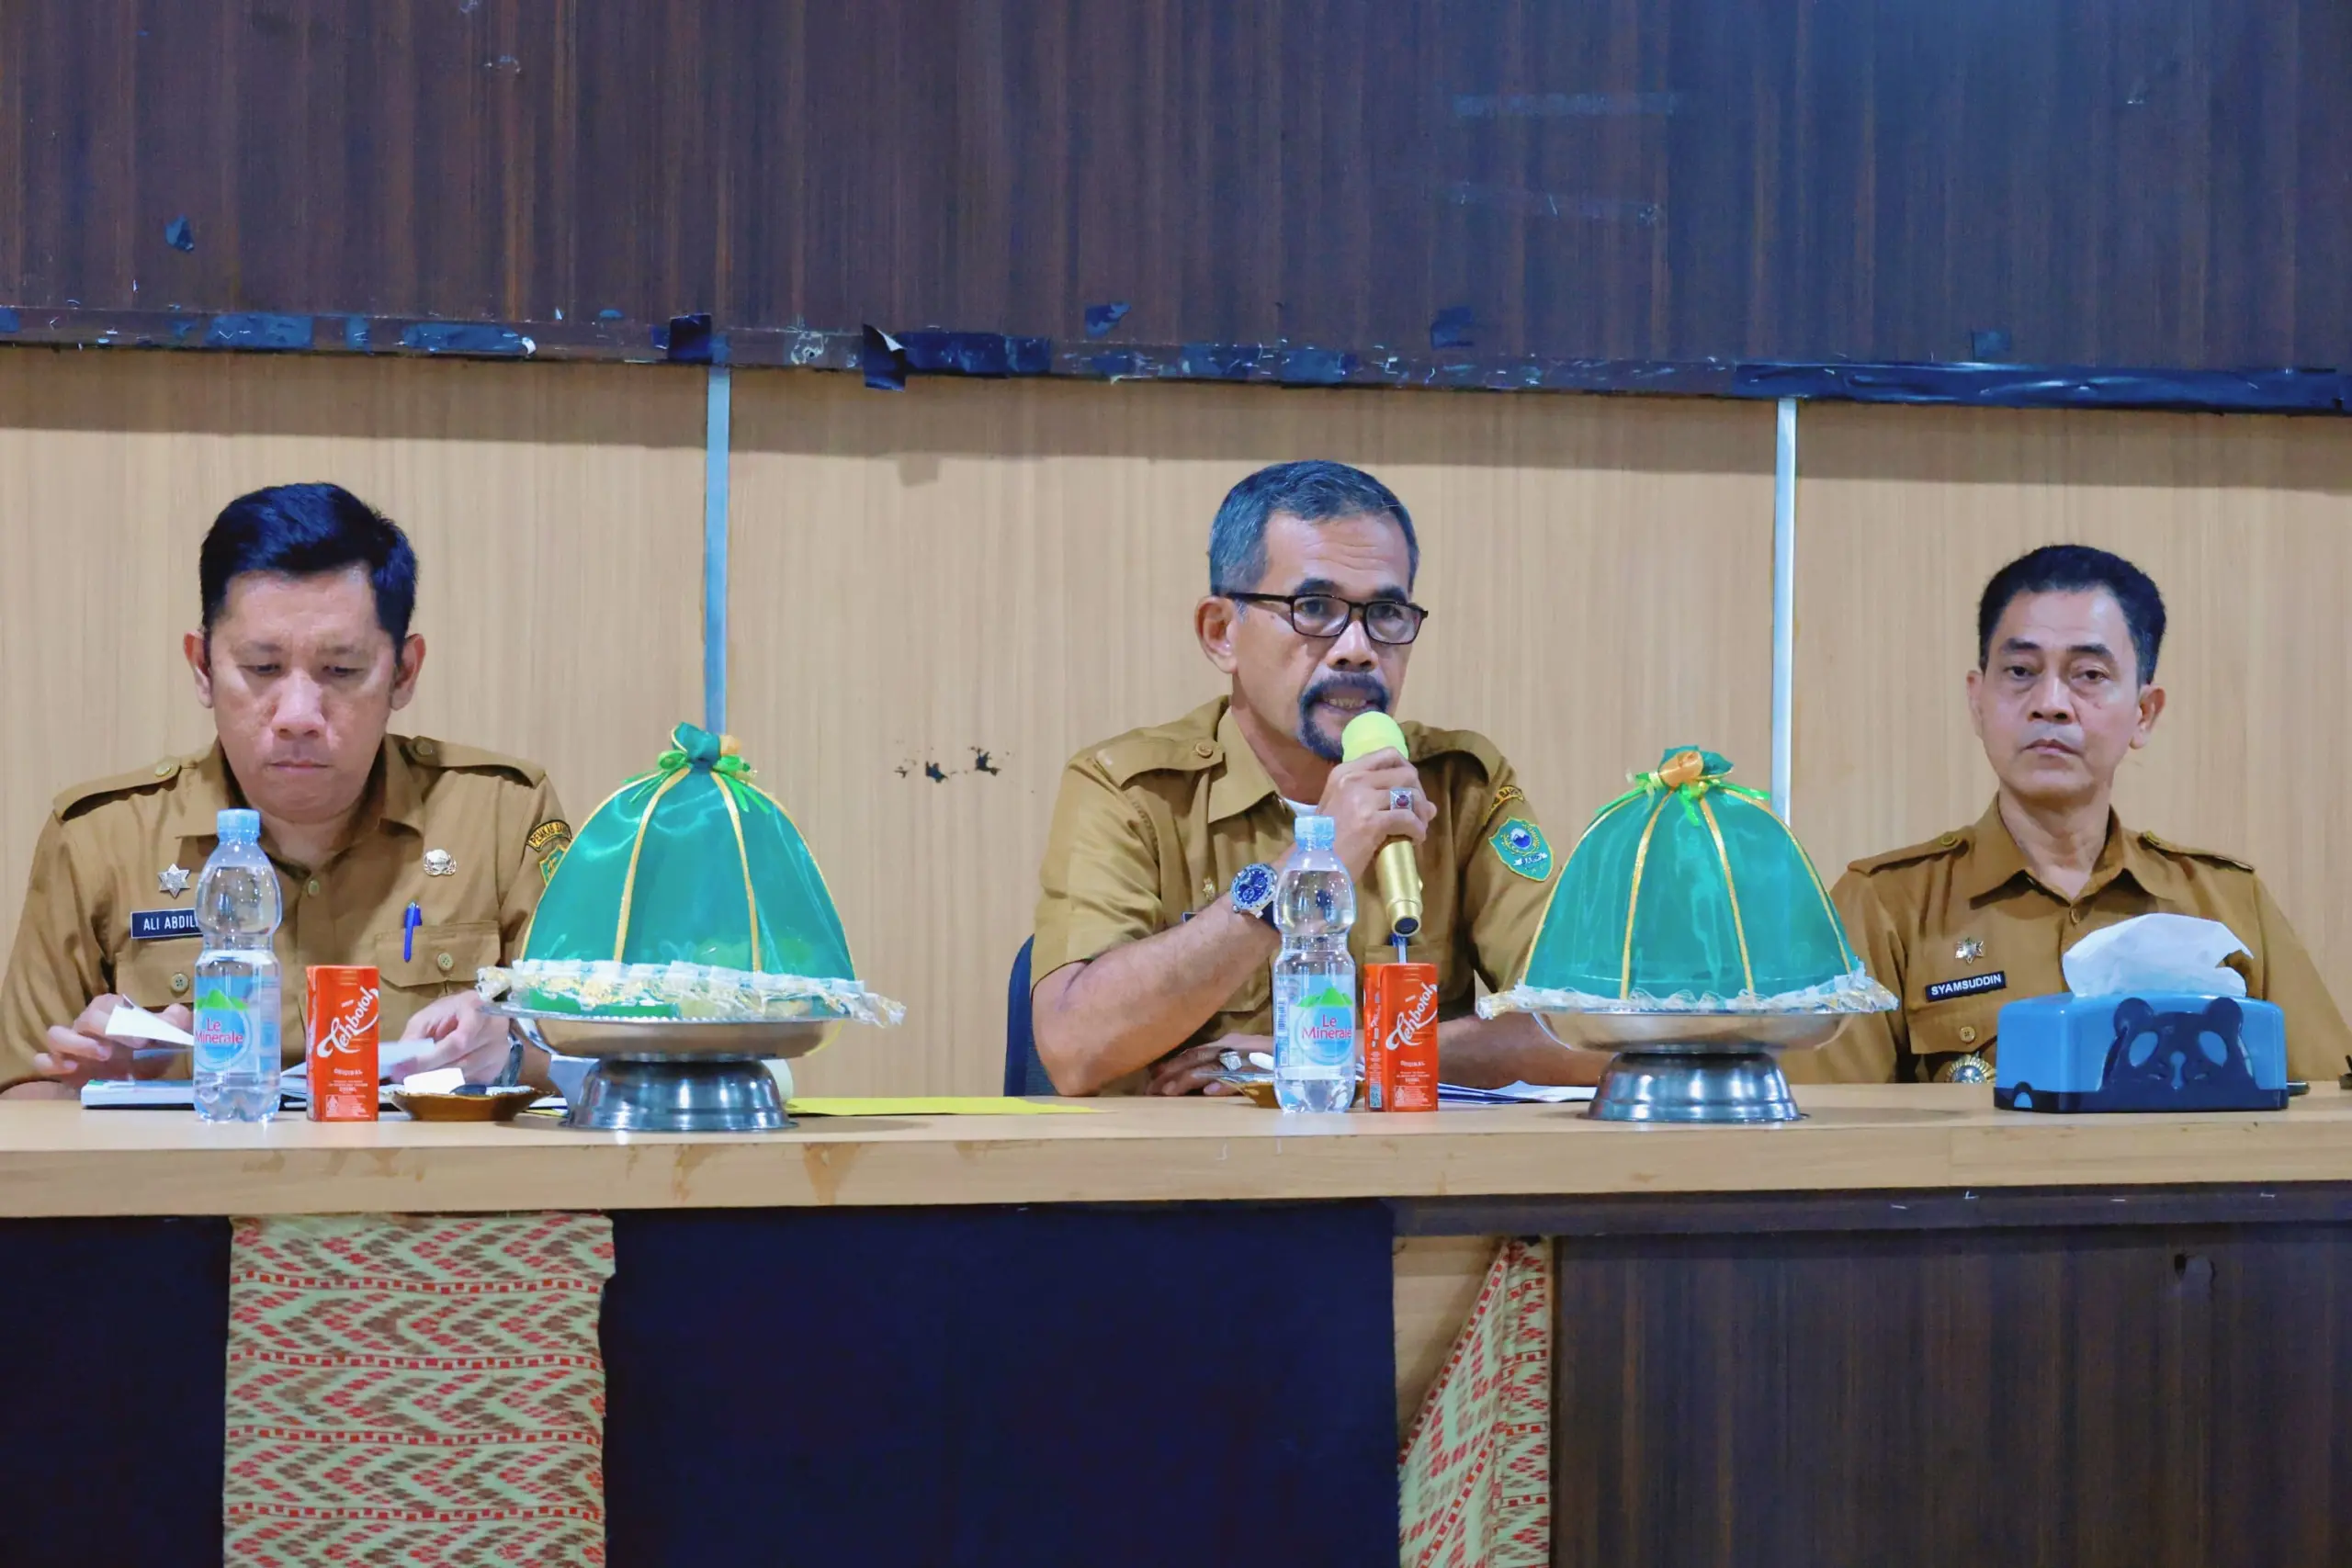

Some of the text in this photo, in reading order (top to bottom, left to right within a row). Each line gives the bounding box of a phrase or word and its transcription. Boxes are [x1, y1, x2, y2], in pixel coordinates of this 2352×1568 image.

[143, 917, 159, 931] ALI
[1931, 974, 2002, 996] SYAMSUDDIN
[316, 986, 379, 1058] Tehbotol
[1322, 1013, 1337, 1028] Le
[1385, 981, 1438, 1051] Tehbotol
[207, 1017, 220, 1032] Le
[195, 1029, 243, 1044] Minerale
[1301, 1027, 1352, 1040] Minerale
